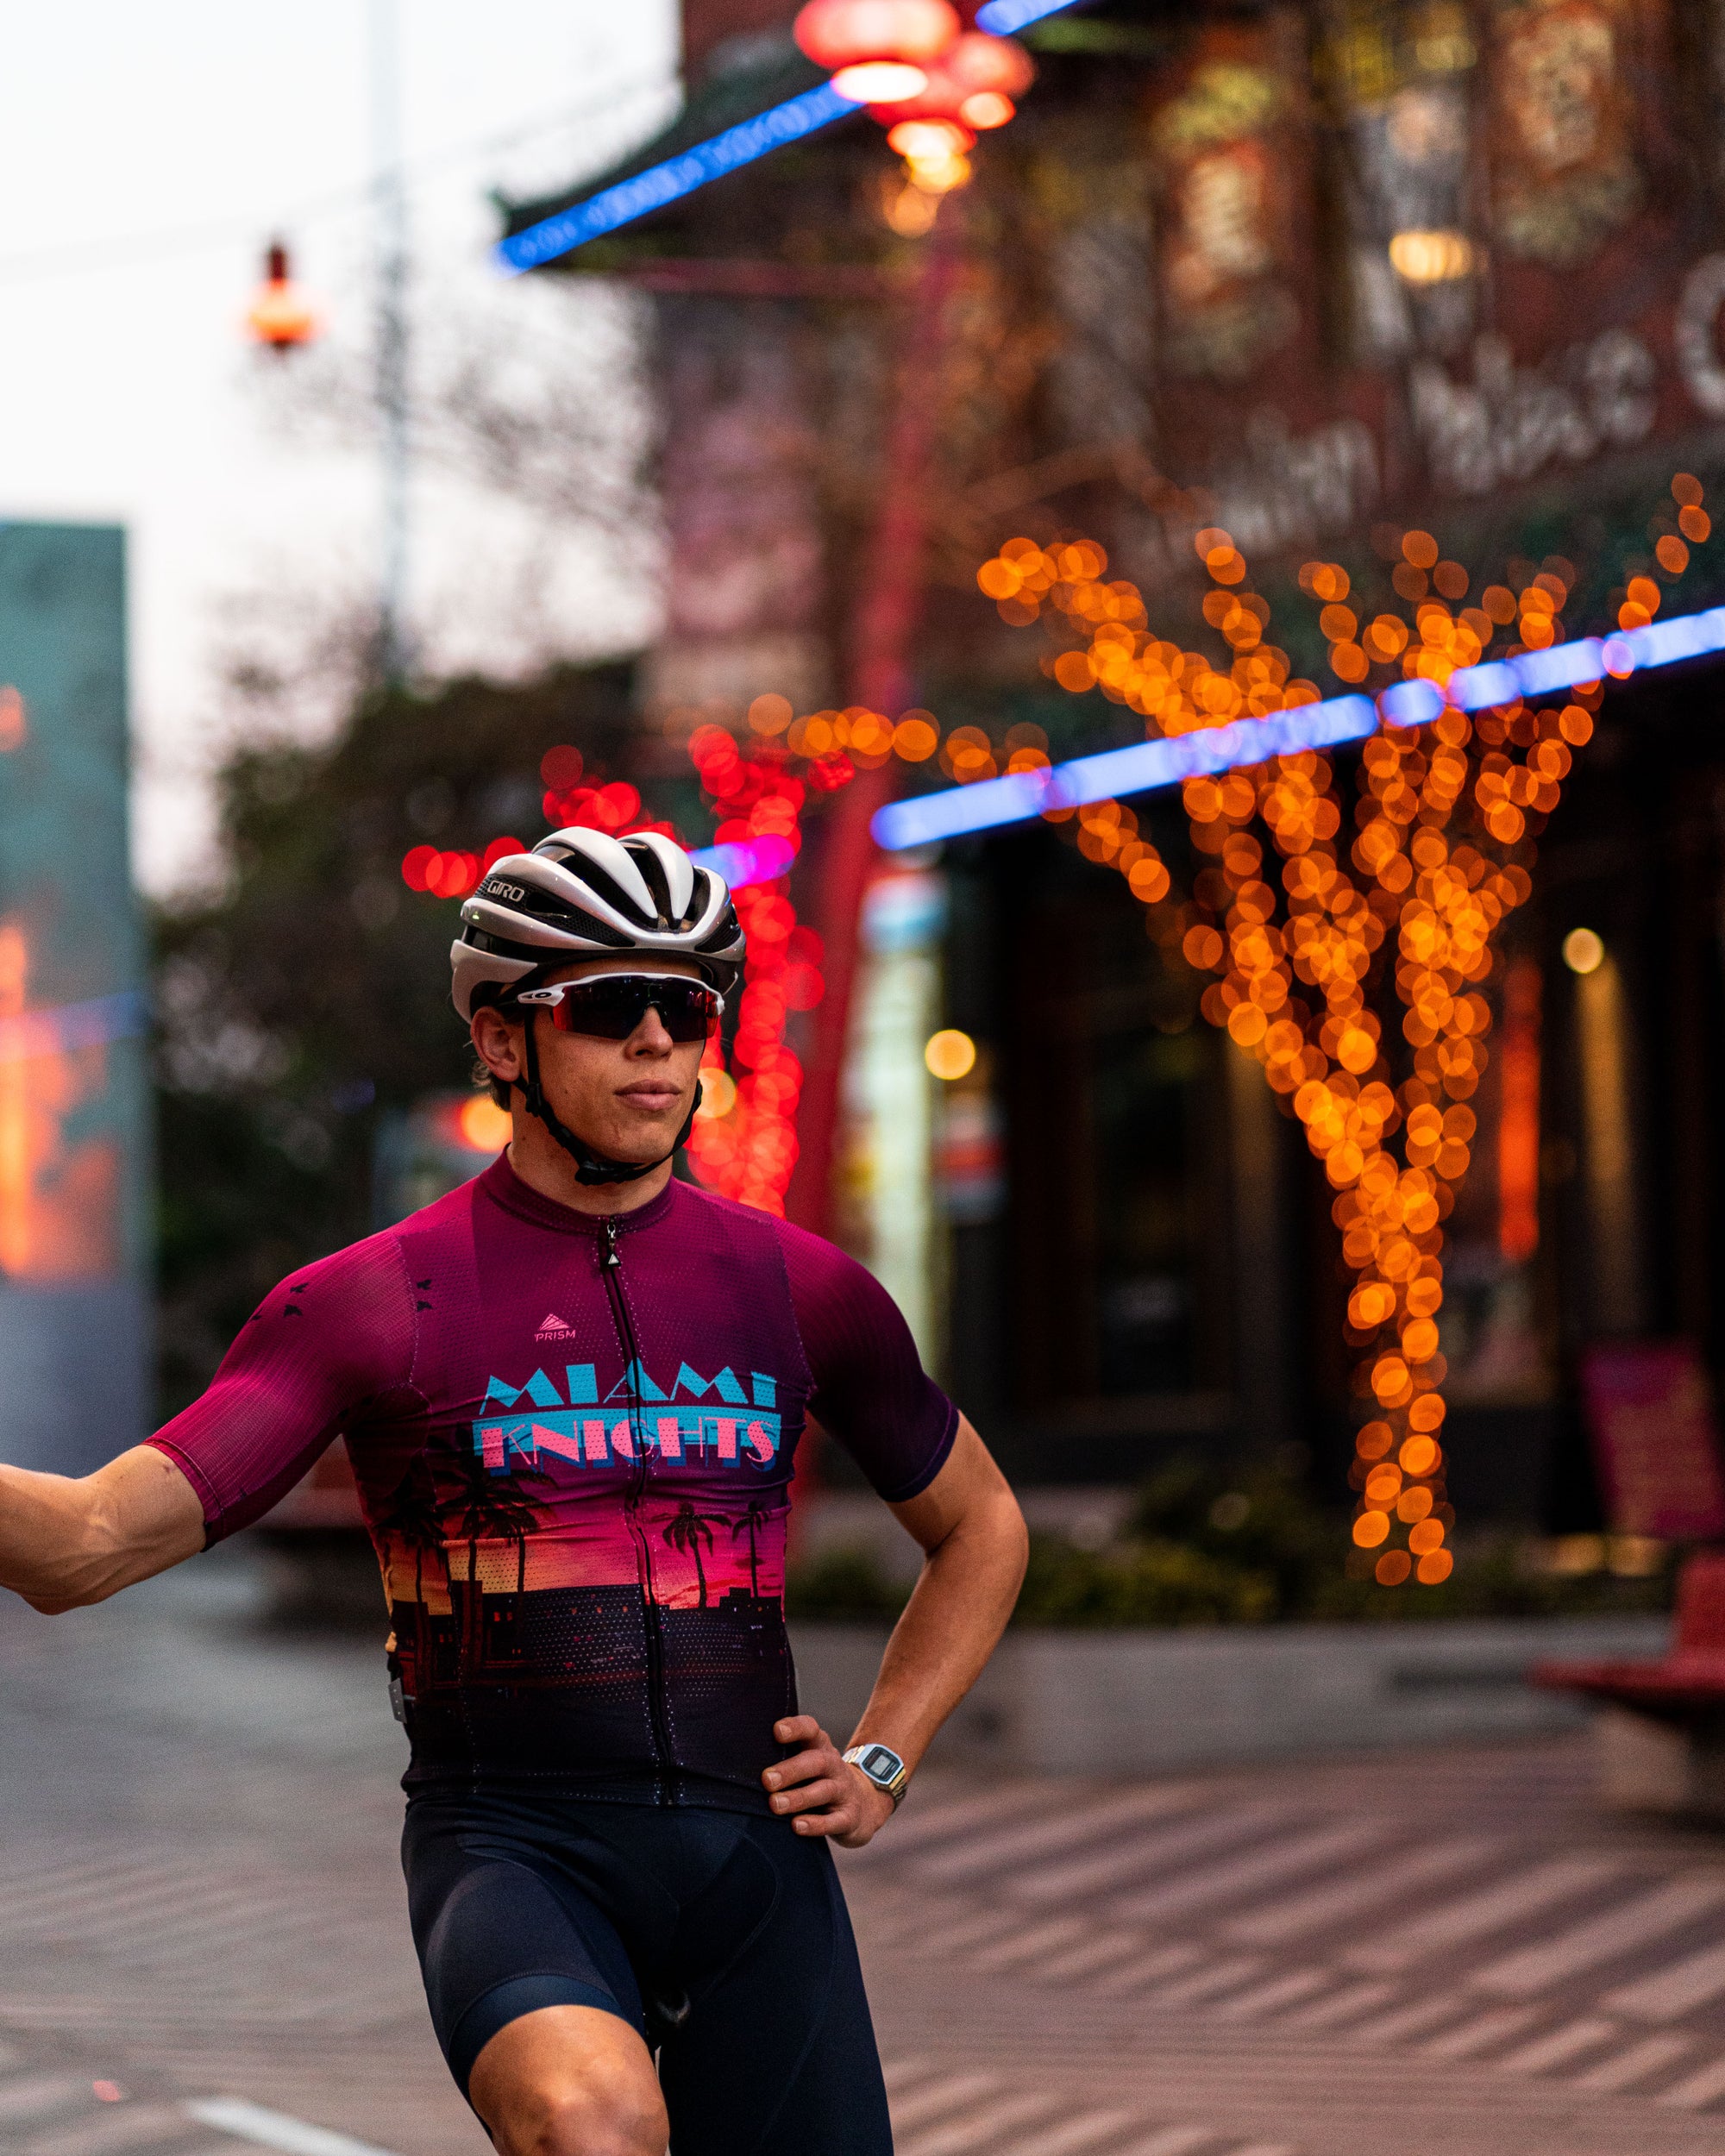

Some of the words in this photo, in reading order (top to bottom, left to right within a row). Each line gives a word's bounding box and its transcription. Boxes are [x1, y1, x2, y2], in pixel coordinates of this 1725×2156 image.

[487, 880, 524, 902] GIRO
[535, 1329, 575, 1343] PRISM
[479, 1357, 777, 1416] MIAMI
[480, 1416, 775, 1469] KNIGHTS
